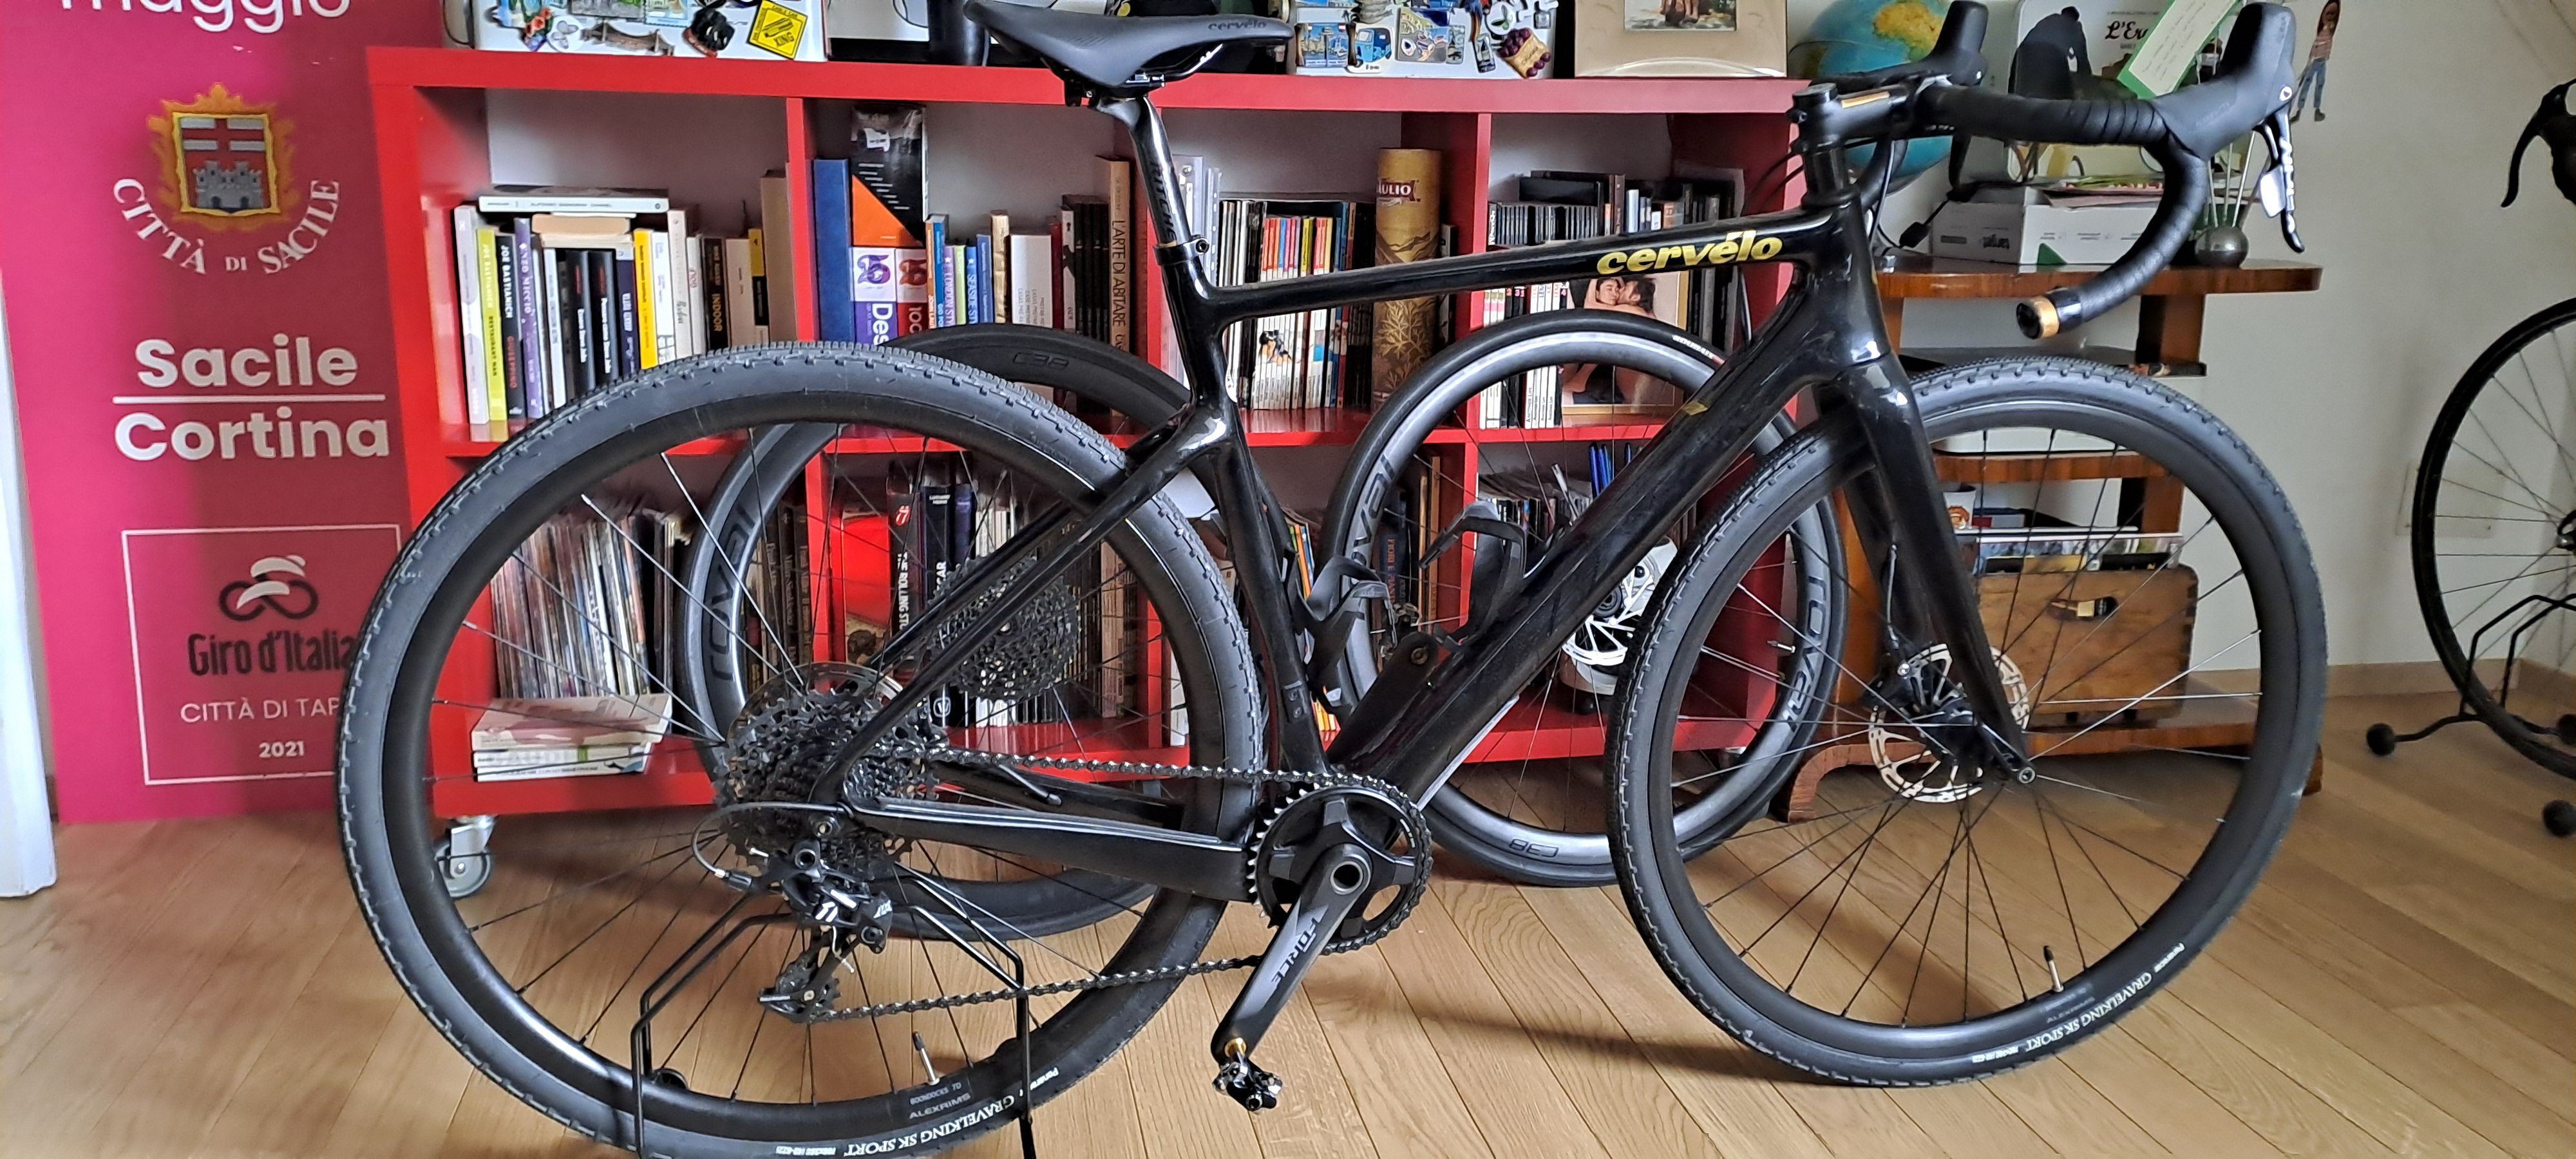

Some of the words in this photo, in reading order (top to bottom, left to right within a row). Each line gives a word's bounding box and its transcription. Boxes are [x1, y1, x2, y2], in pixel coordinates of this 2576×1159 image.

[1148, 161, 1177, 242] RITCHE
[1376, 184, 1412, 196] AULIO
[113, 178, 207, 275] CITTÀ
[225, 256, 247, 272] DI
[256, 180, 341, 275] SACILE
[1112, 220, 1126, 259] L'ARTE
[500, 245, 509, 262] JOE
[1113, 261, 1126, 275] DI
[1596, 230, 1783, 275] cervélo
[502, 264, 514, 319] BASTIANICH
[945, 272, 954, 307] LONDON
[967, 274, 977, 308] SEASIDE
[1113, 278, 1126, 327] ABITARE
[712, 293, 723, 332] INDOOR
[945, 310, 955, 326] STY
[135, 332, 359, 388] Sacile
[115, 405, 390, 462] Cortina
[898, 572, 909, 612] ROLLING
[187, 633, 253, 676] Giro
[258, 630, 354, 674] d'Italia
[180, 697, 254, 723] CITTÀ
[263, 699, 289, 719] DI
[298, 697, 340, 718] TAP
[259, 740, 305, 759] 2021
[1270, 915, 1321, 988] FORCE
[2080, 972, 2152, 1028] GRAVELKING
[2025, 1028, 2064, 1053] SPORT
[2063, 1017, 2081, 1036] SK
[909, 1092, 971, 1120] ALEXRIMS
[921, 1095, 1015, 1145] GRAVELKING
[843, 1139, 896, 1158] SPORT
[897, 1135, 918, 1151] SK
